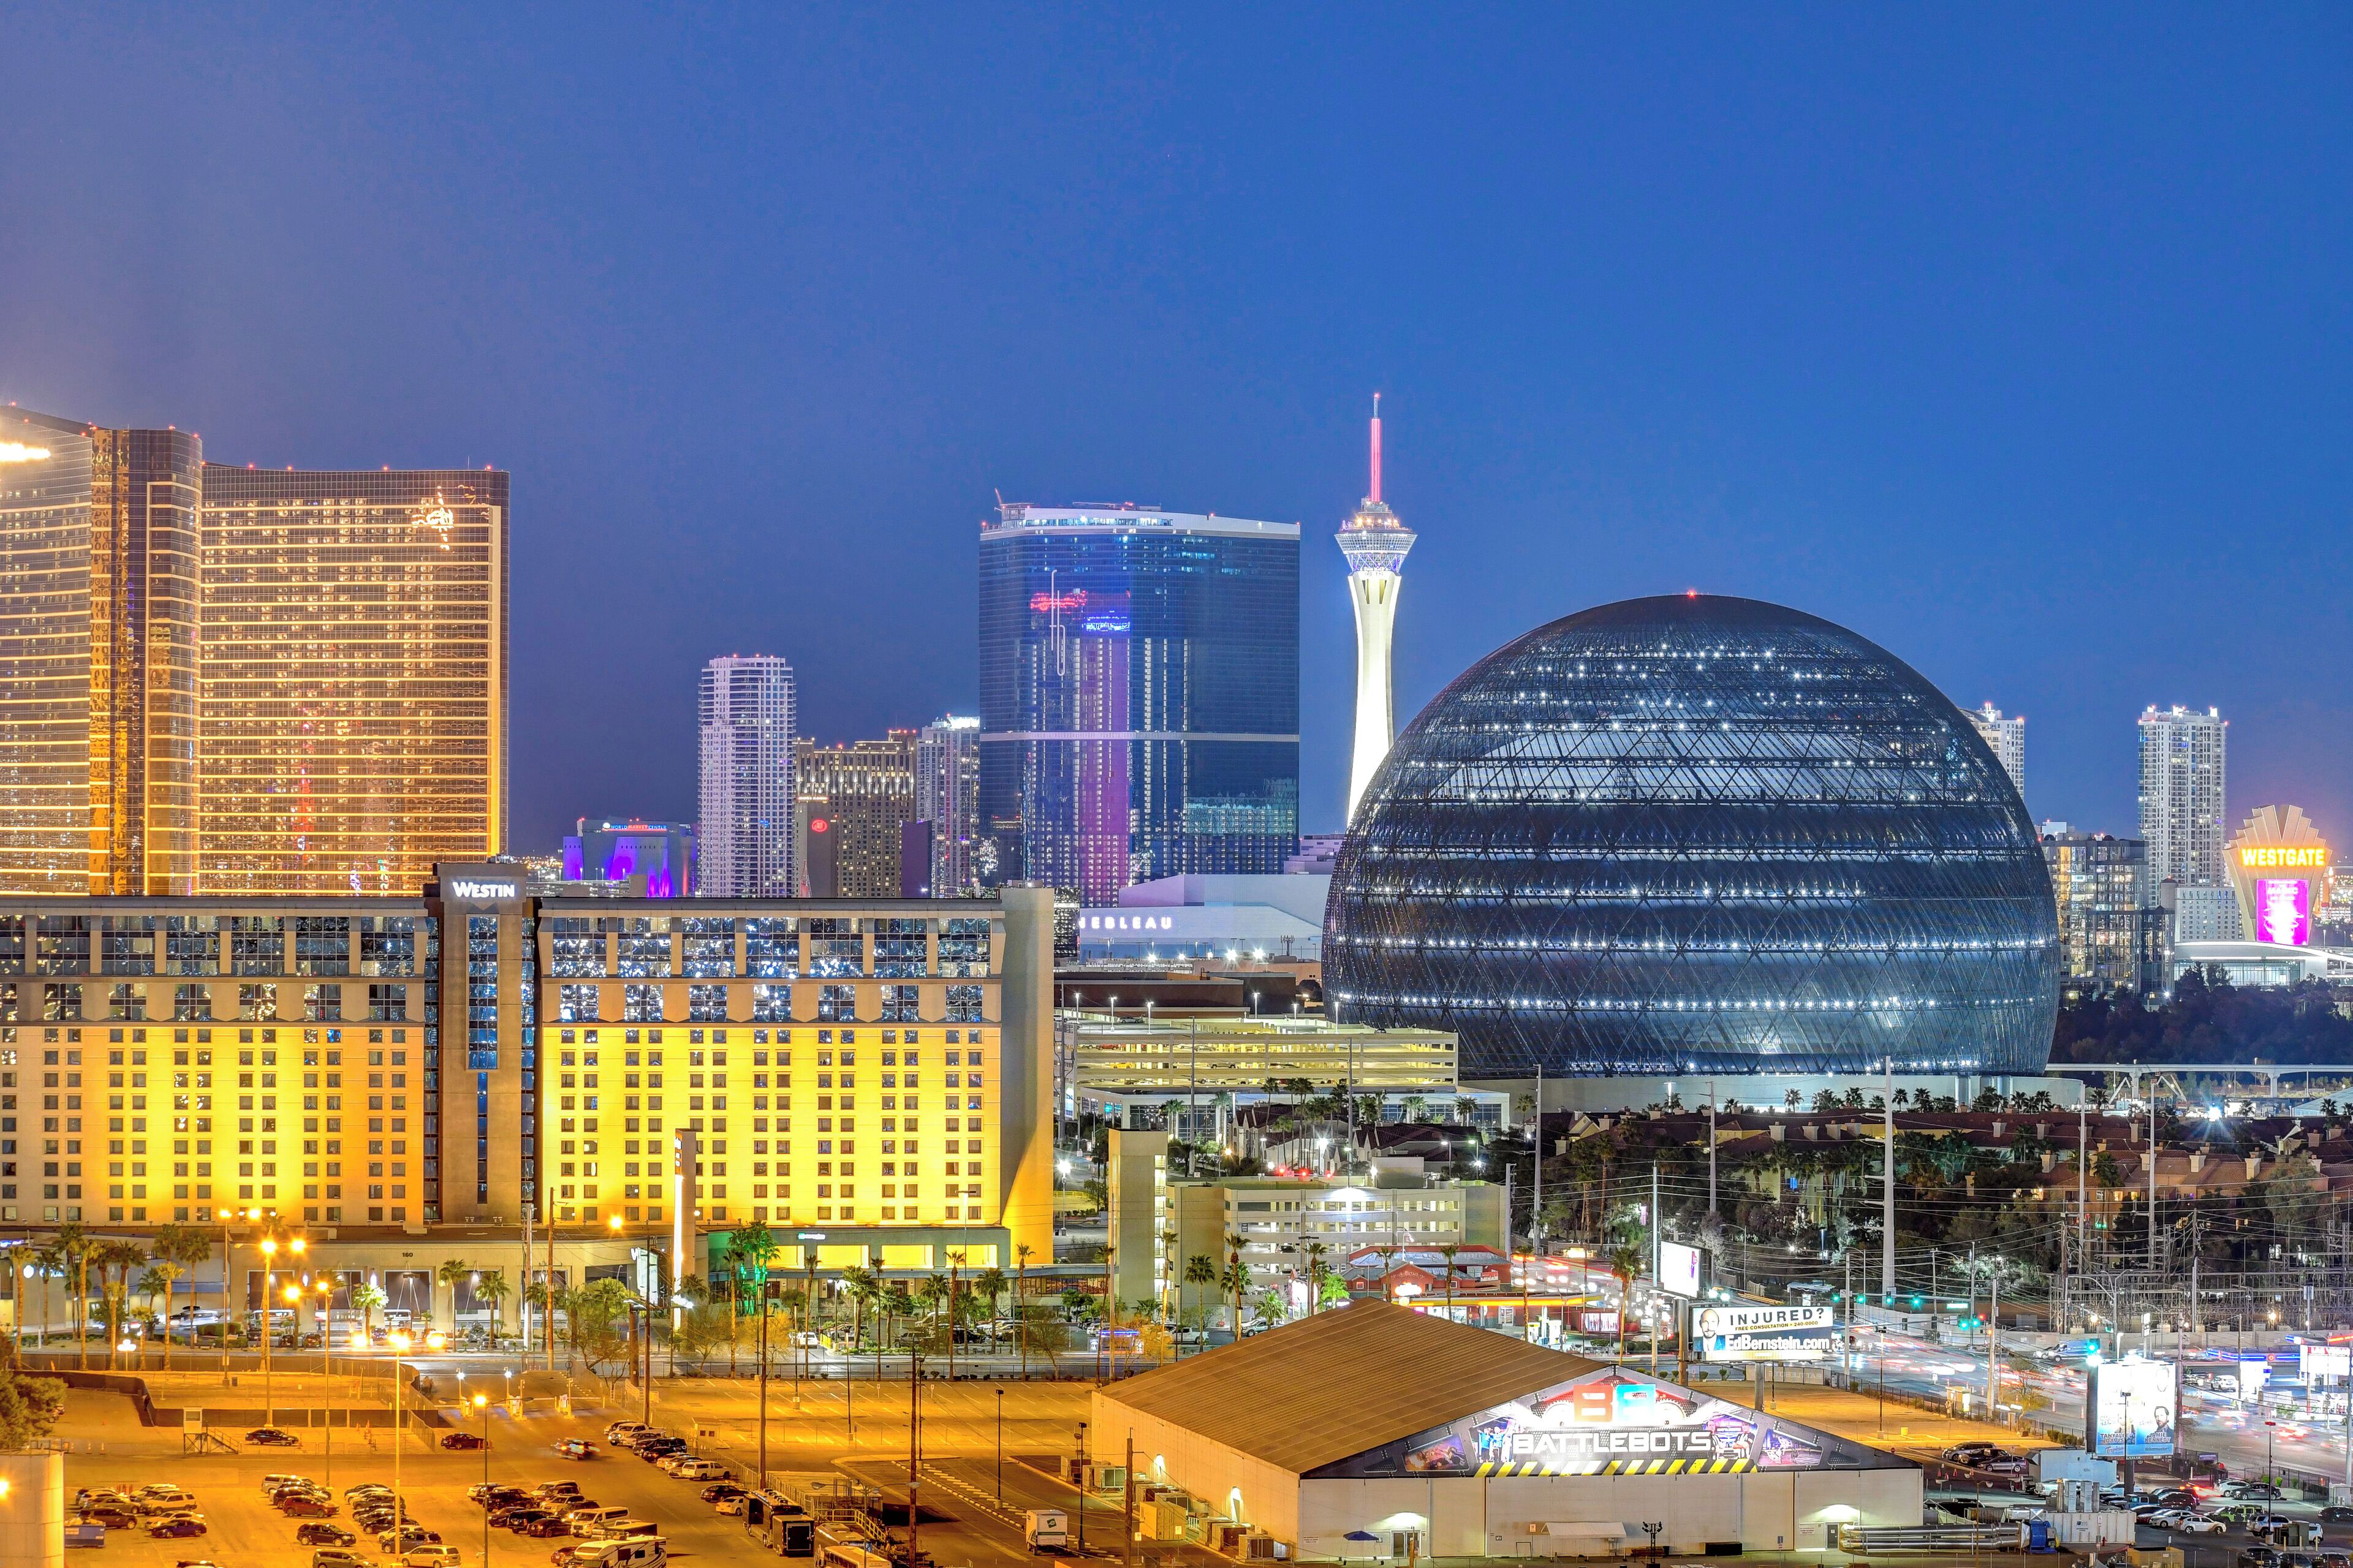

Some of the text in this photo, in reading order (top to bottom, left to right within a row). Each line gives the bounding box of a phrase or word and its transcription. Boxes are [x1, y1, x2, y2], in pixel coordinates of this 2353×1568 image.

[2241, 848, 2325, 866] WESTGATE
[1730, 1308, 1824, 1325] INJURED?
[1725, 1334, 1830, 1350] EdBernstein.com
[1514, 1432, 1711, 1453] BATTLEBOTS
